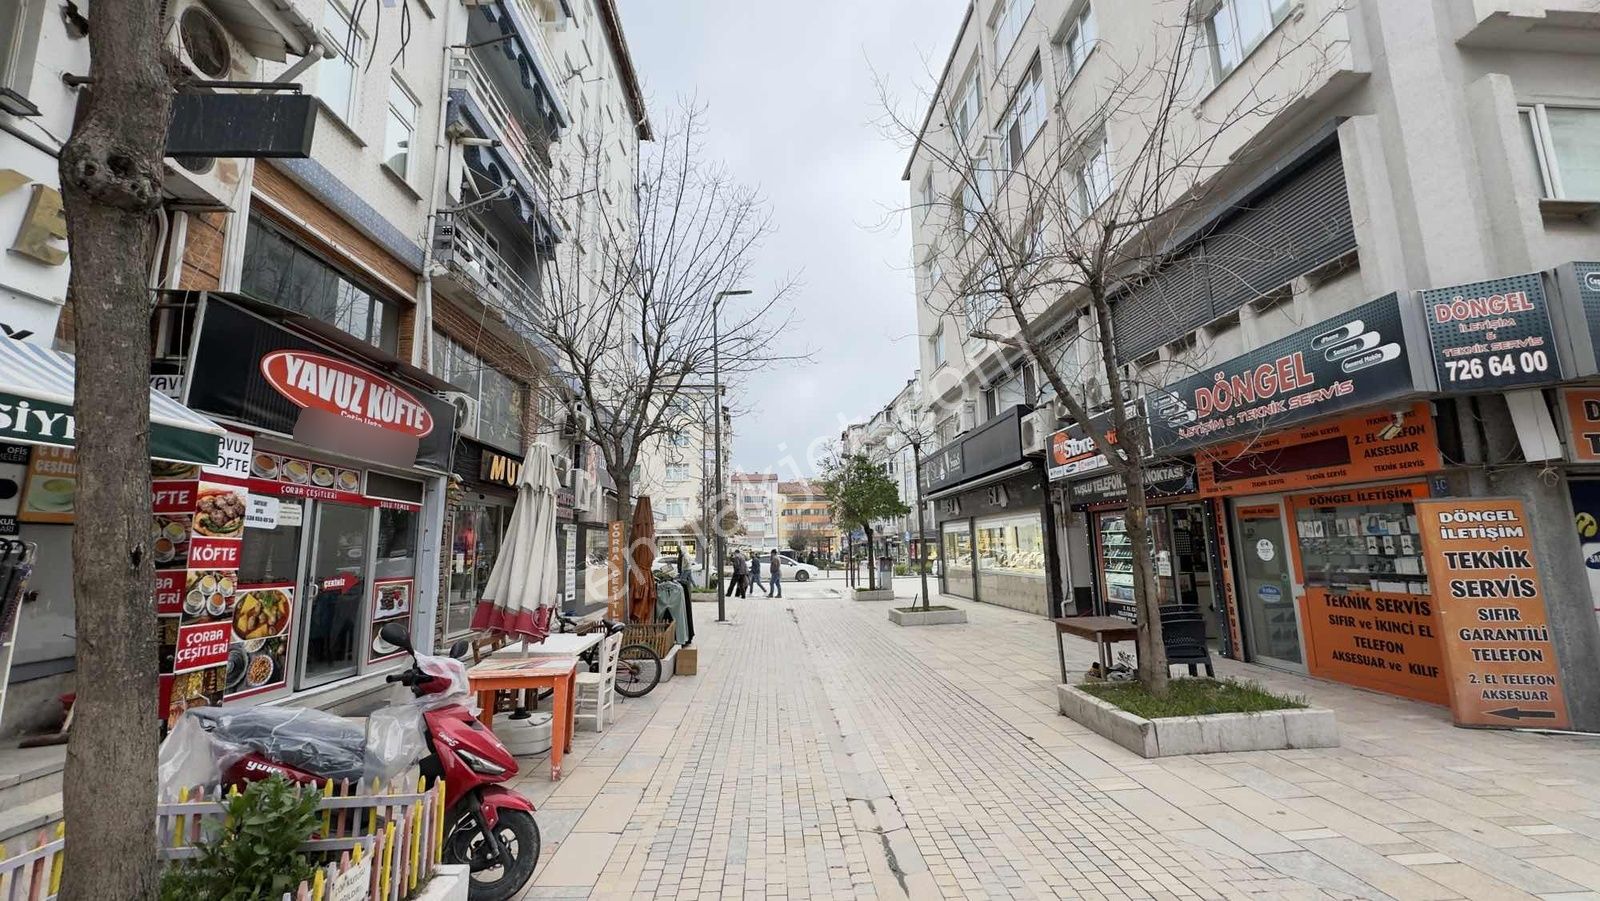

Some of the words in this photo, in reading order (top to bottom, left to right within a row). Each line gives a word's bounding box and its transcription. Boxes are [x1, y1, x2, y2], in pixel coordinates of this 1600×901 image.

[1434, 292, 1535, 323] DÖNGEL
[1458, 317, 1517, 334] İLETİŞİM
[1442, 343, 1490, 357] TEKNİK
[1491, 335, 1545, 351] SERVİS
[1445, 358, 1485, 381] 726
[1488, 354, 1516, 377] 64
[1520, 350, 1549, 373] 00
[284, 353, 366, 415] YAVUZ
[367, 383, 424, 429] KÖFTE
[1195, 352, 1314, 419] DÖNGEL
[1236, 401, 1288, 424] TEKNİK
[1287, 379, 1355, 410] SERVİS
[1353, 434, 1364, 446] 2.
[1365, 442, 1419, 459] AKSESUAR
[1093, 474, 1123, 492] TELEFON
[1145, 466, 1184, 484] NOKTASI
[151, 490, 190, 506] FTE
[1309, 493, 1353, 507] DÖNGEL
[1356, 488, 1413, 502] İLETİŞİM
[1438, 510, 1519, 524] DÖNGEL
[1440, 525, 1523, 542] İLETİŞİM
[192, 544, 238, 562] KÖFTE
[1444, 546, 1532, 571] TEKNİK
[1450, 575, 1537, 600] SERVİS
[1324, 592, 1372, 611] TEKNİK
[1375, 597, 1432, 616] SERVİS
[1478, 606, 1521, 622] SIFIR
[1328, 614, 1356, 628] SIFIR
[1358, 618, 1373, 631] ve
[1418, 624, 1435, 639] EL
[1459, 625, 1549, 642] GARANTİLİ
[186, 629, 224, 644] ÇORBA
[1353, 635, 1405, 655] TELEFON
[177, 641, 229, 663] ÇEŞİTLERİ
[1470, 647, 1543, 663] TELEFON
[1332, 649, 1387, 669] AKSESUAR
[1388, 660, 1403, 672] ve
[1408, 662, 1440, 679] KILIF
[1469, 673, 1481, 685] 2.
[1485, 674, 1498, 685] EL
[1503, 674, 1556, 686] TELEFON
[1481, 688, 1549, 702] AKSESUAR
